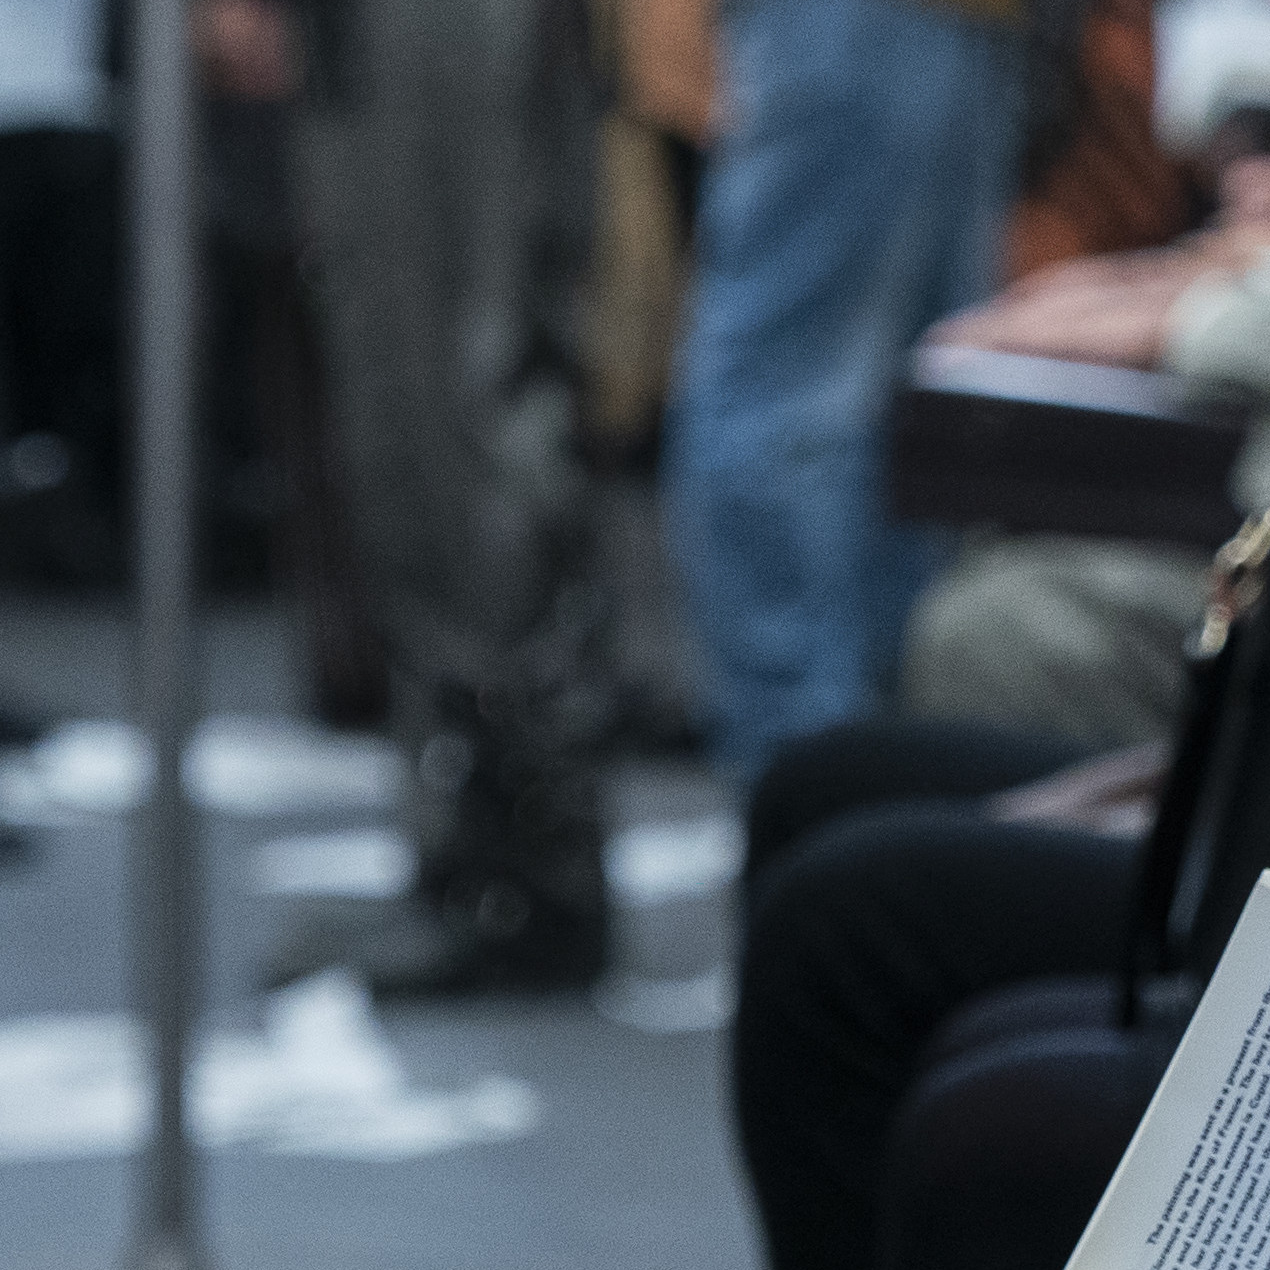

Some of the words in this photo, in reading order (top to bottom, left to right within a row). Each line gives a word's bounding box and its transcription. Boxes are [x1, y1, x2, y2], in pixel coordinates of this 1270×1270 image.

[1144, 1222, 1165, 1245] The
[1160, 1170, 1192, 1223] painting
[1185, 1143, 1204, 1169] was
[1199, 1113, 1217, 1141] sent
[1225, 1037, 1252, 1086] present
[1245, 1006, 1266, 1037] from
[1184, 1186, 1200, 1207] the
[1195, 1156, 1217, 1184] King
[1238, 1066, 1256, 1089] The
[1250, 1042, 1268, 1066] boy
[1175, 1240, 1192, 1265] and
[1185, 1195, 1216, 1239] kissing
[1209, 1172, 1226, 1193] the
[1221, 1125, 1247, 1170] woman
[1189, 1247, 1206, 1269] her
[1200, 1215, 1224, 1246] body
[1225, 1144, 1255, 1200] arranged
[1248, 1121, 1267, 1144] has
[1229, 1175, 1259, 1231] arranged
[1239, 1223, 1255, 1244] the
[1250, 1234, 1268, 1257] has
